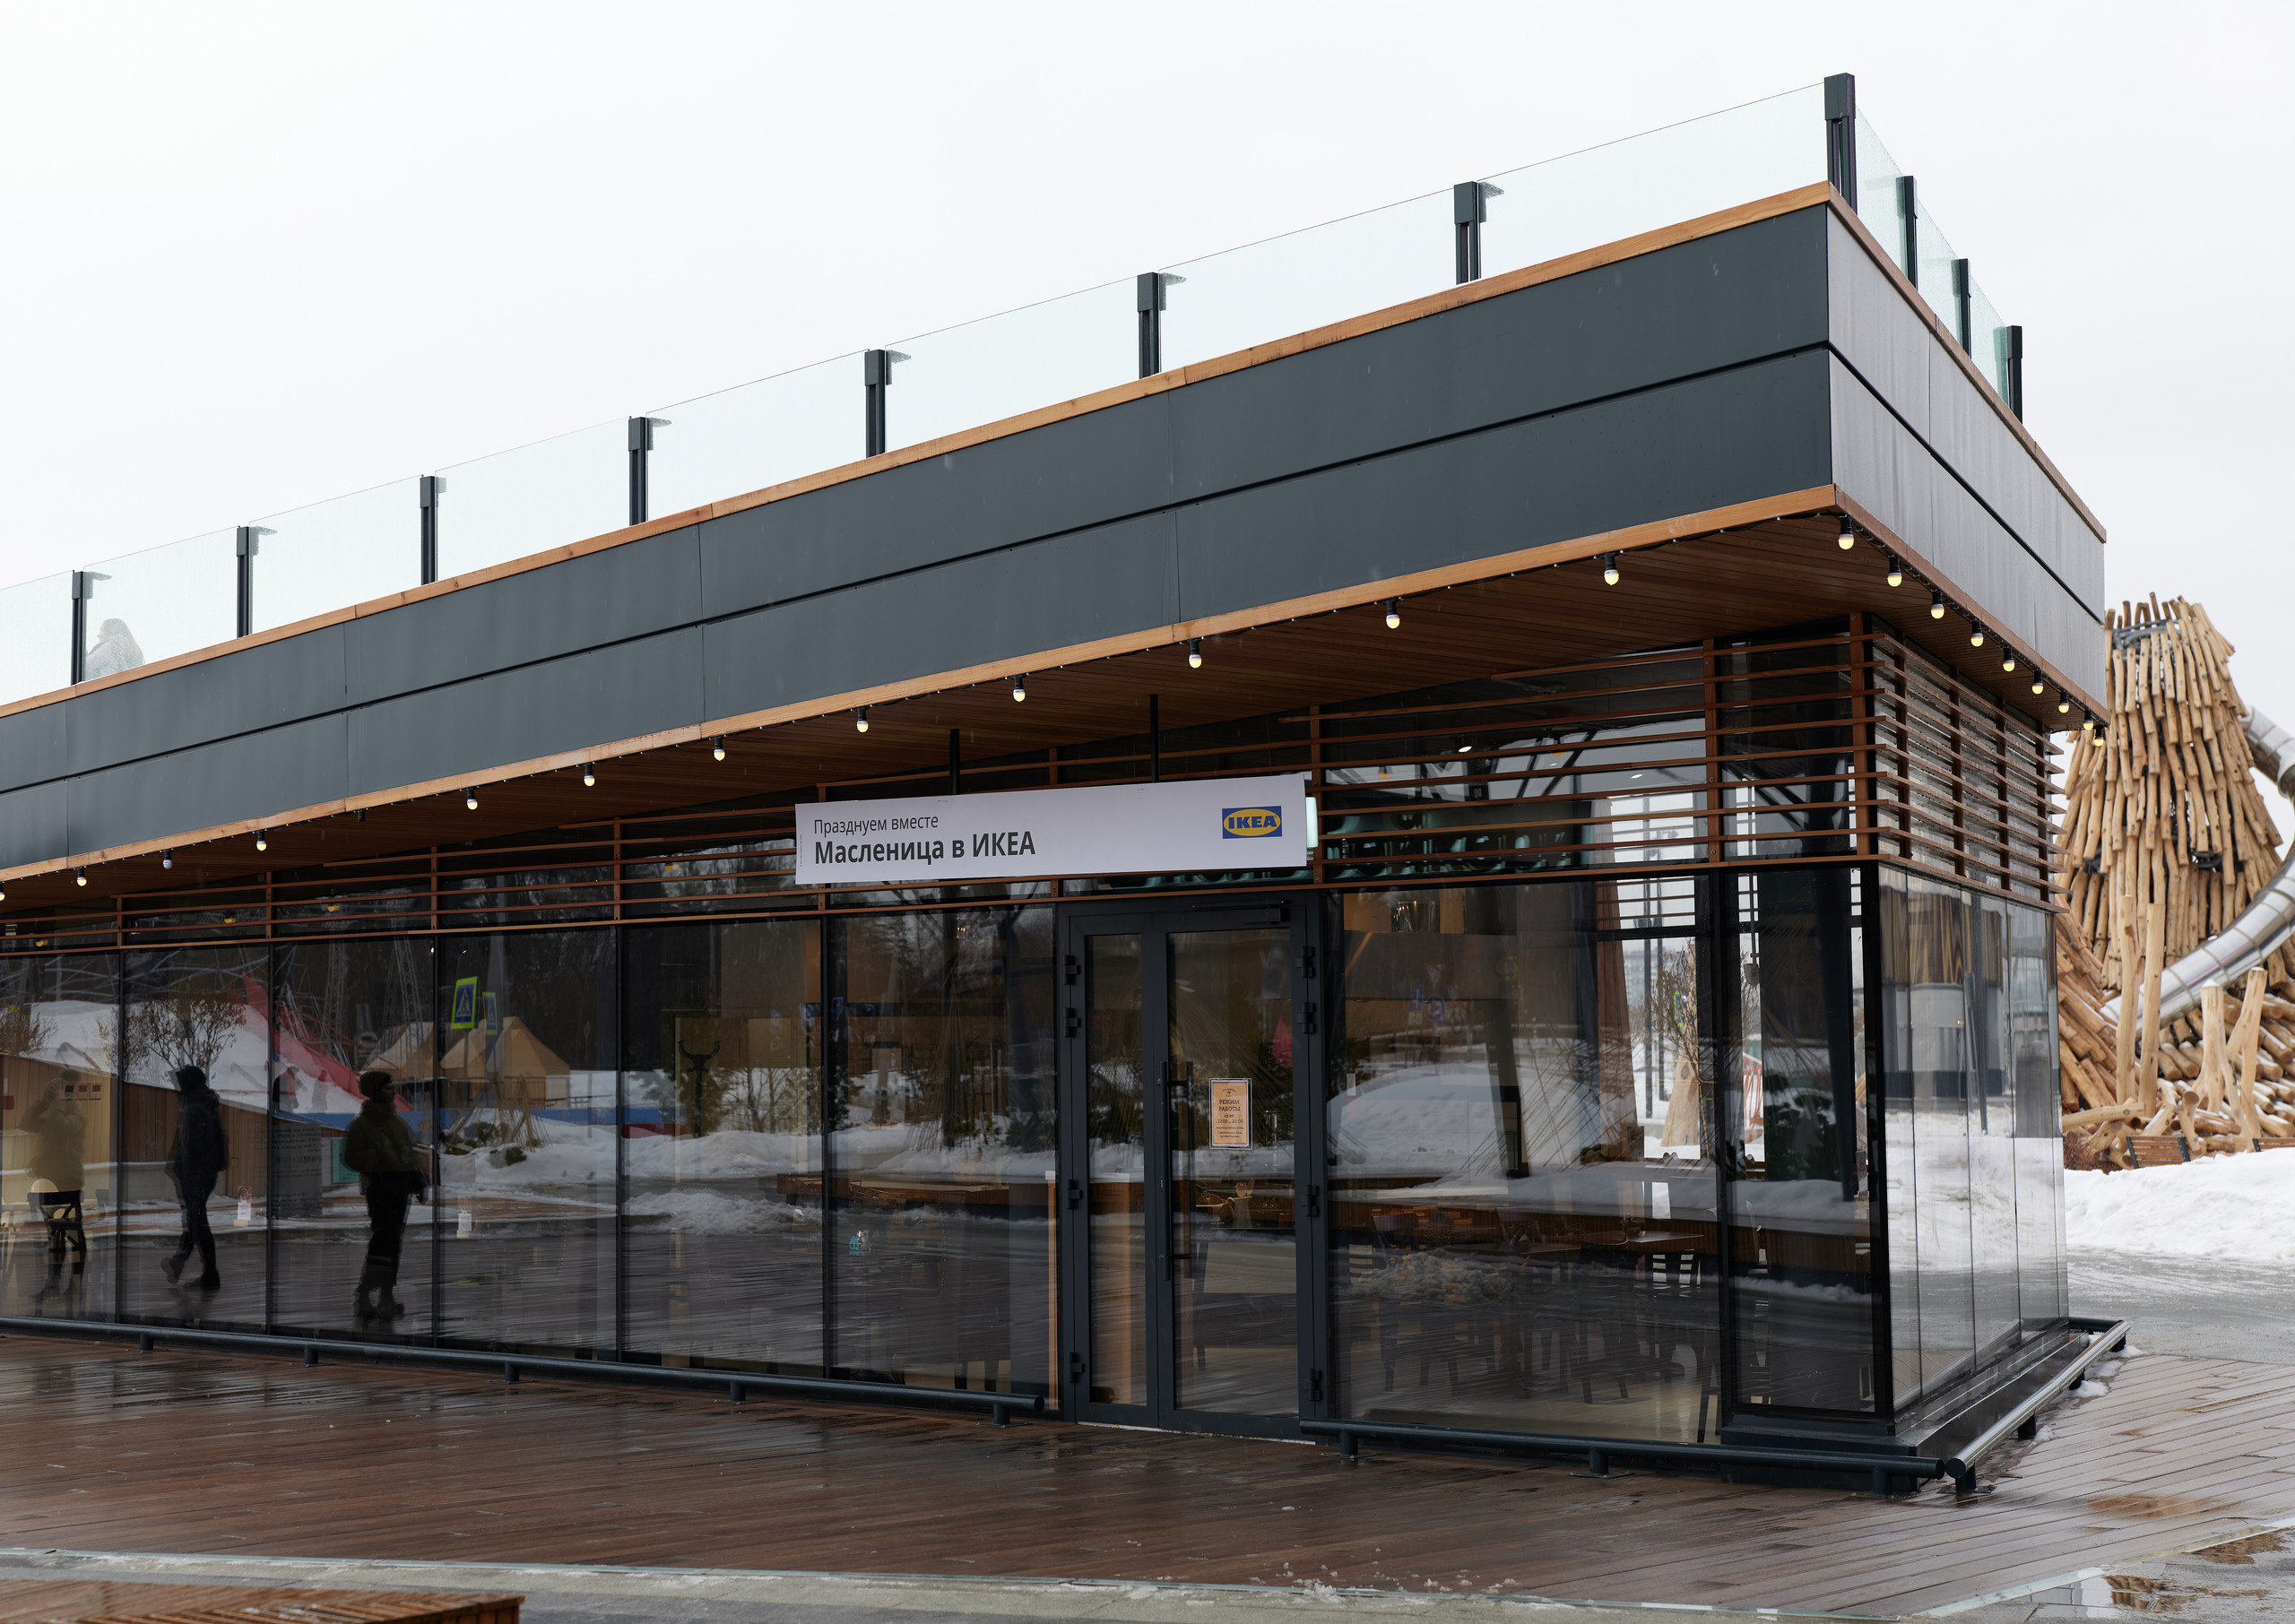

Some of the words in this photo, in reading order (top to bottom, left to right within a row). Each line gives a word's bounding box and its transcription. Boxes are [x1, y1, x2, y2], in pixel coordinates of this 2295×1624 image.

[815, 818, 888, 837] Празднуем
[892, 816, 939, 831] вместе
[1228, 816, 1277, 829] IKEA
[815, 840, 944, 865] Масленица
[952, 839, 966, 858] в
[974, 831, 1036, 857] ИКЕА
